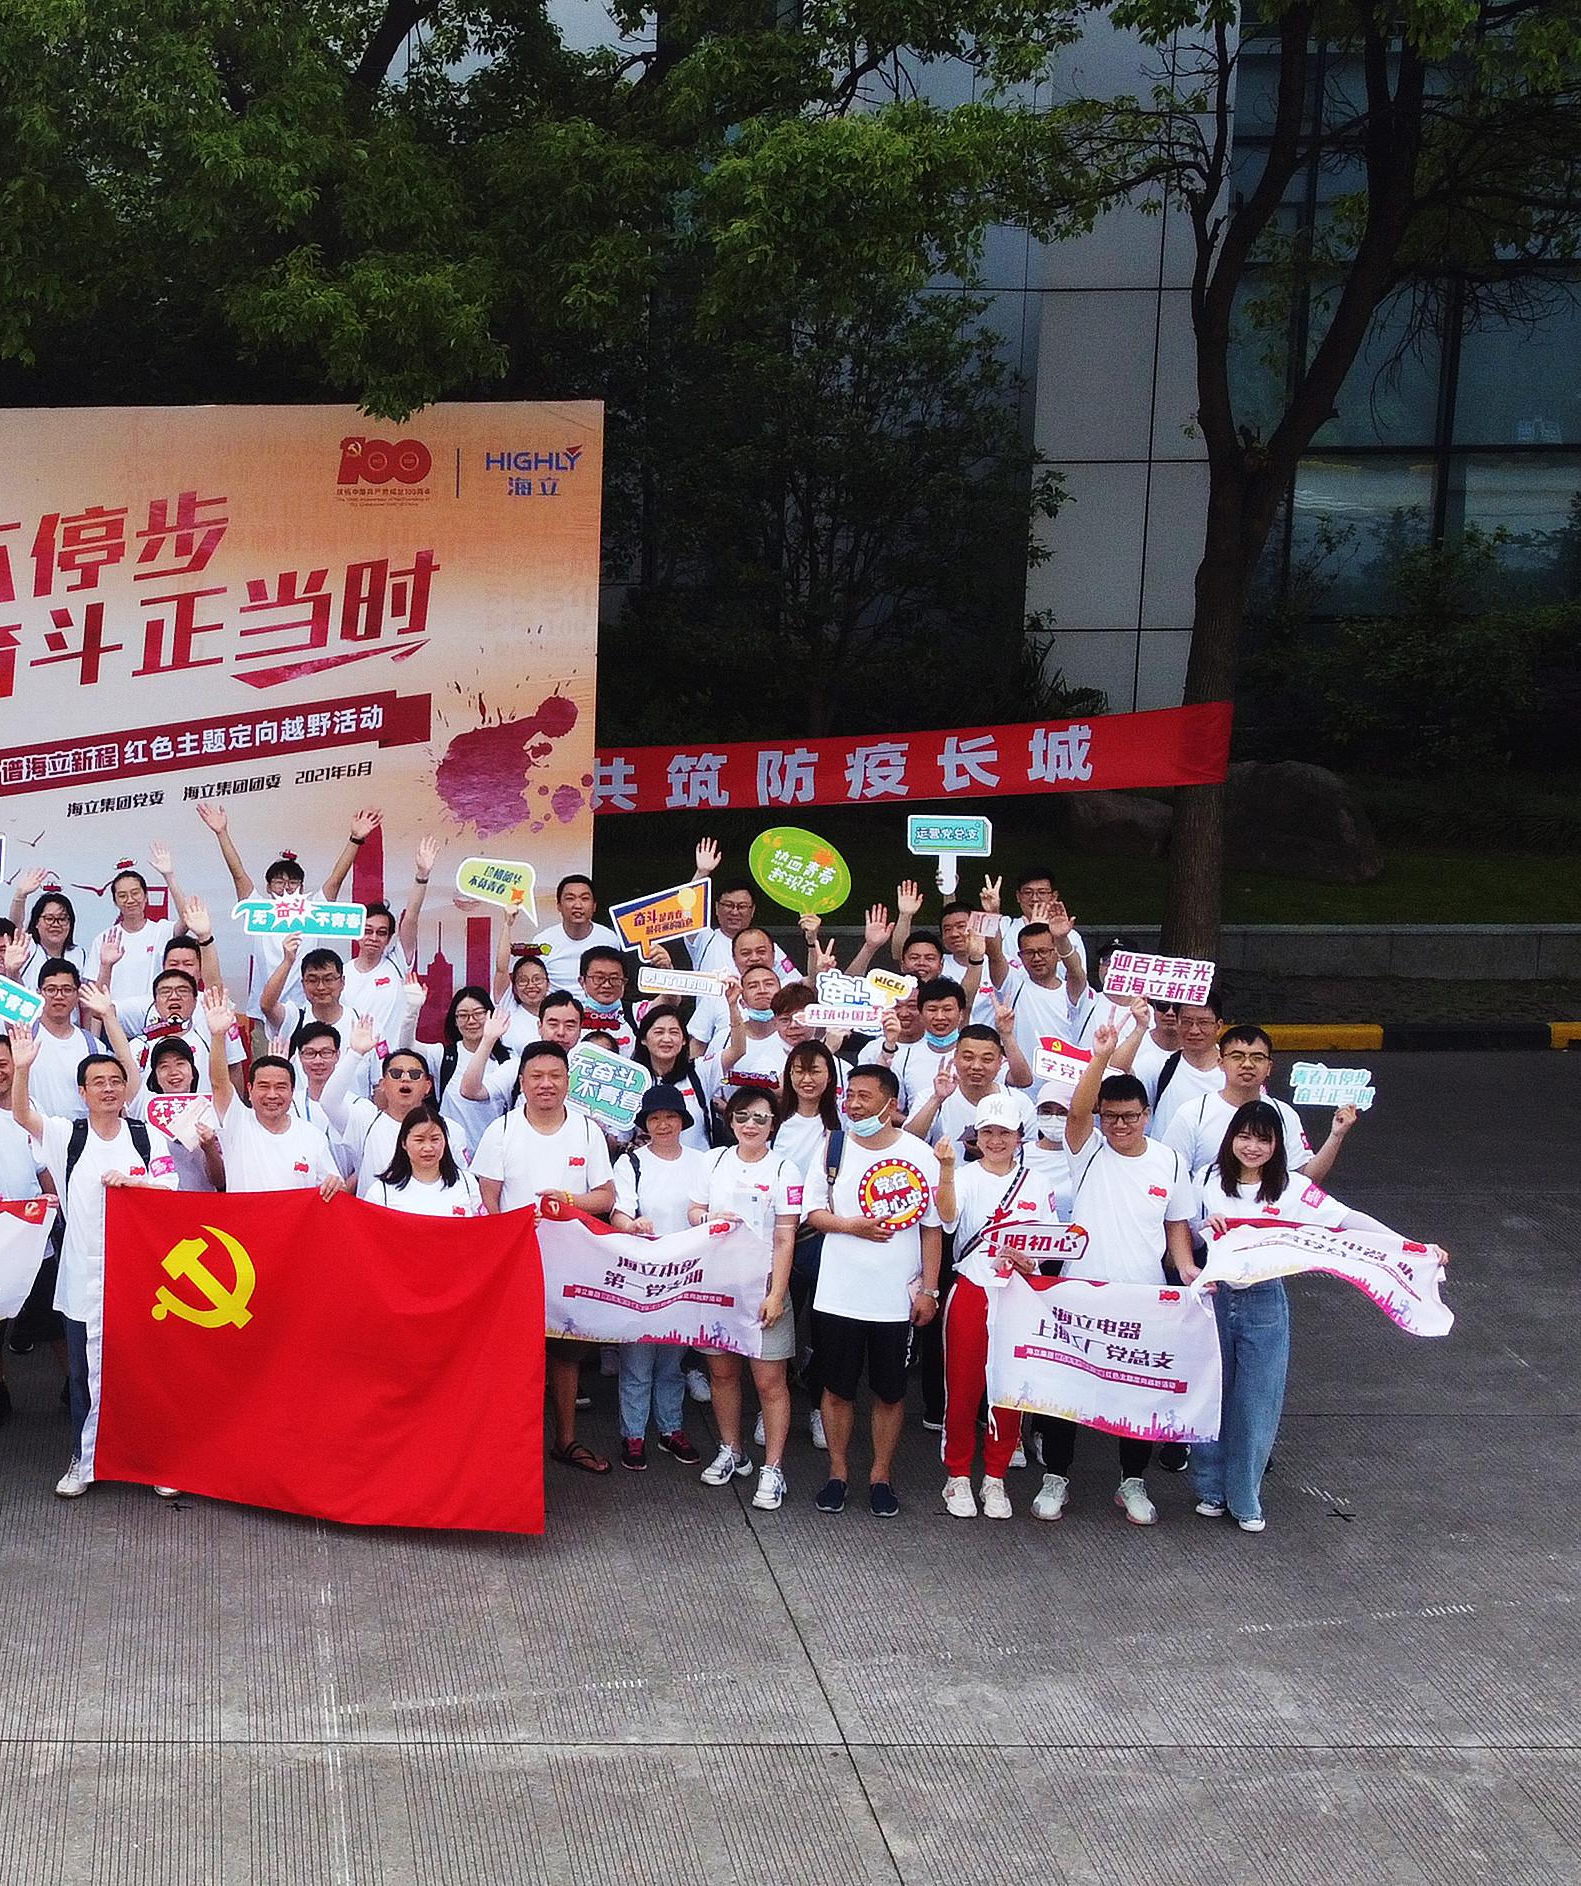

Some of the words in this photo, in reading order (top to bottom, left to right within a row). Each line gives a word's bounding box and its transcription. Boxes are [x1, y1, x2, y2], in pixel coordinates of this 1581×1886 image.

[485, 445, 582, 471] HIGHLY
[507, 476, 561, 496] 海立
[0, 743, 119, 785] 谱海立新程
[123, 704, 385, 765] 红色主题定向越野活动
[593, 725, 1093, 811] 共筑防疫长城
[67, 790, 165, 818] 海立集团党委
[183, 774, 282, 802] 海立集团团委
[294, 761, 372, 785] 2021年6月
[771, 849, 836, 885] 热血青春
[768, 867, 818, 896] 趁现在
[1112, 953, 1211, 981] 迎百年荣光
[874, 975, 905, 994] NICE!
[1106, 974, 1207, 1002] 谱海立新程
[569, 1053, 637, 1088] 无奋斗
[1041, 1057, 1083, 1080] 学党
[1293, 1065, 1370, 1087] 青春不停步
[154, 1098, 191, 1115] 不忘
[574, 1078, 643, 1110] 不青春
[1296, 1087, 1374, 1106] 奋斗正当时
[873, 1171, 910, 1196] 党在
[871, 1189, 924, 1219] 我心中
[1004, 1234, 1078, 1252] 明初心
[1052, 1306, 1142, 1341] 海立电器
